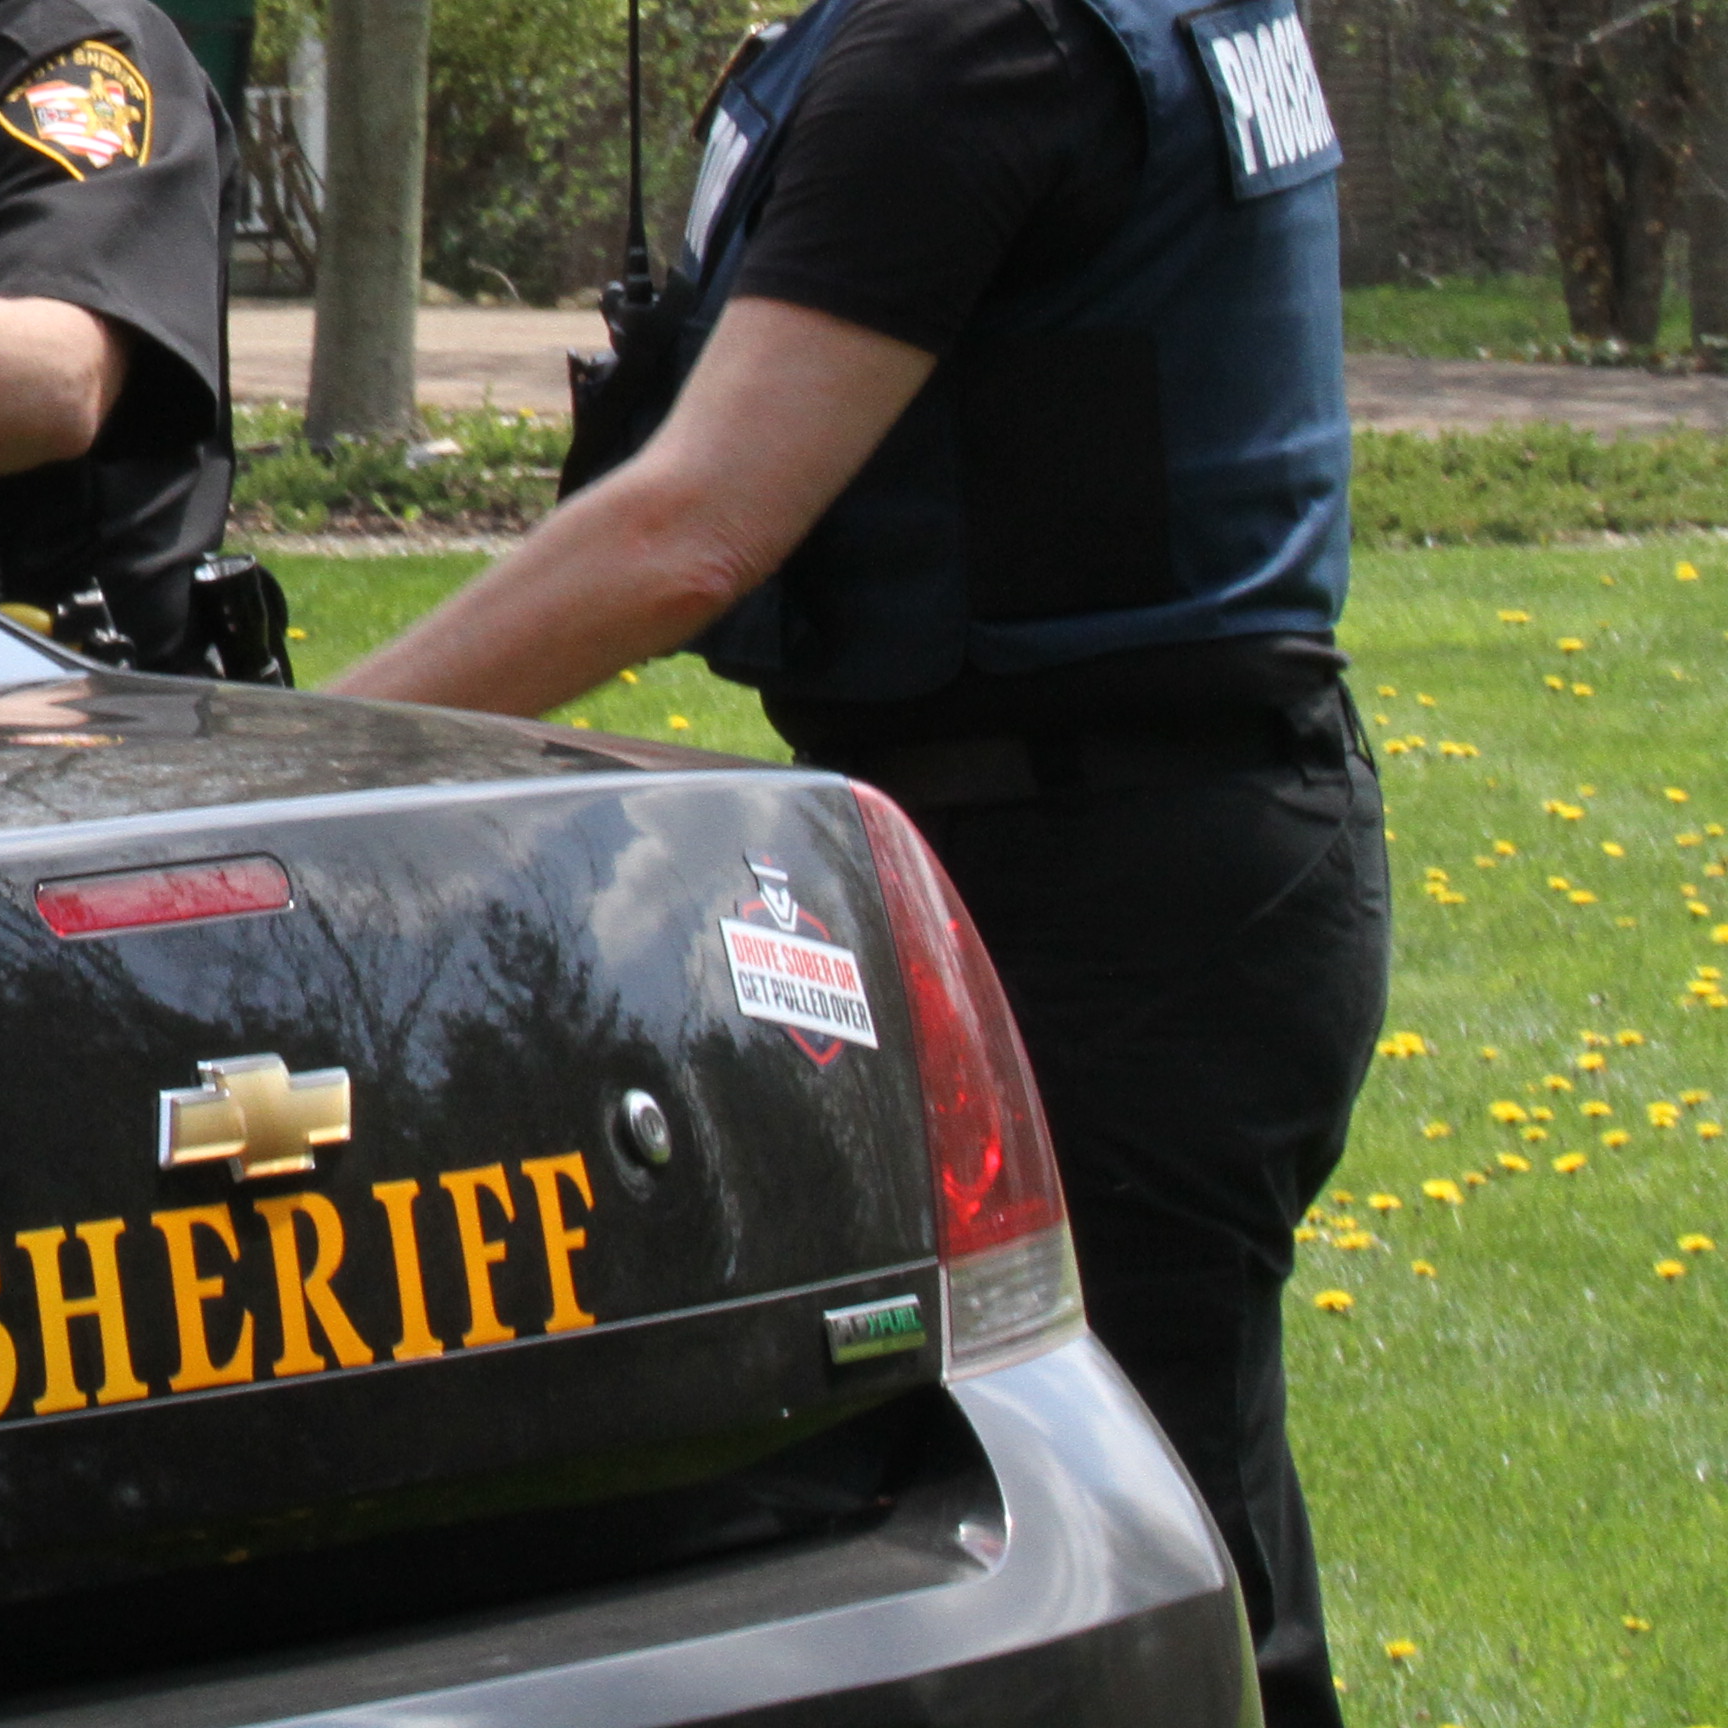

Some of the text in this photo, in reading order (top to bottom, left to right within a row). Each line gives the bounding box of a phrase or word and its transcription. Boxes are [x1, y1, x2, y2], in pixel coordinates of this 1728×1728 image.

[731, 932, 858, 992] DRIVE SOBER OR
[738, 970, 871, 1032] GET PULLED OVER
